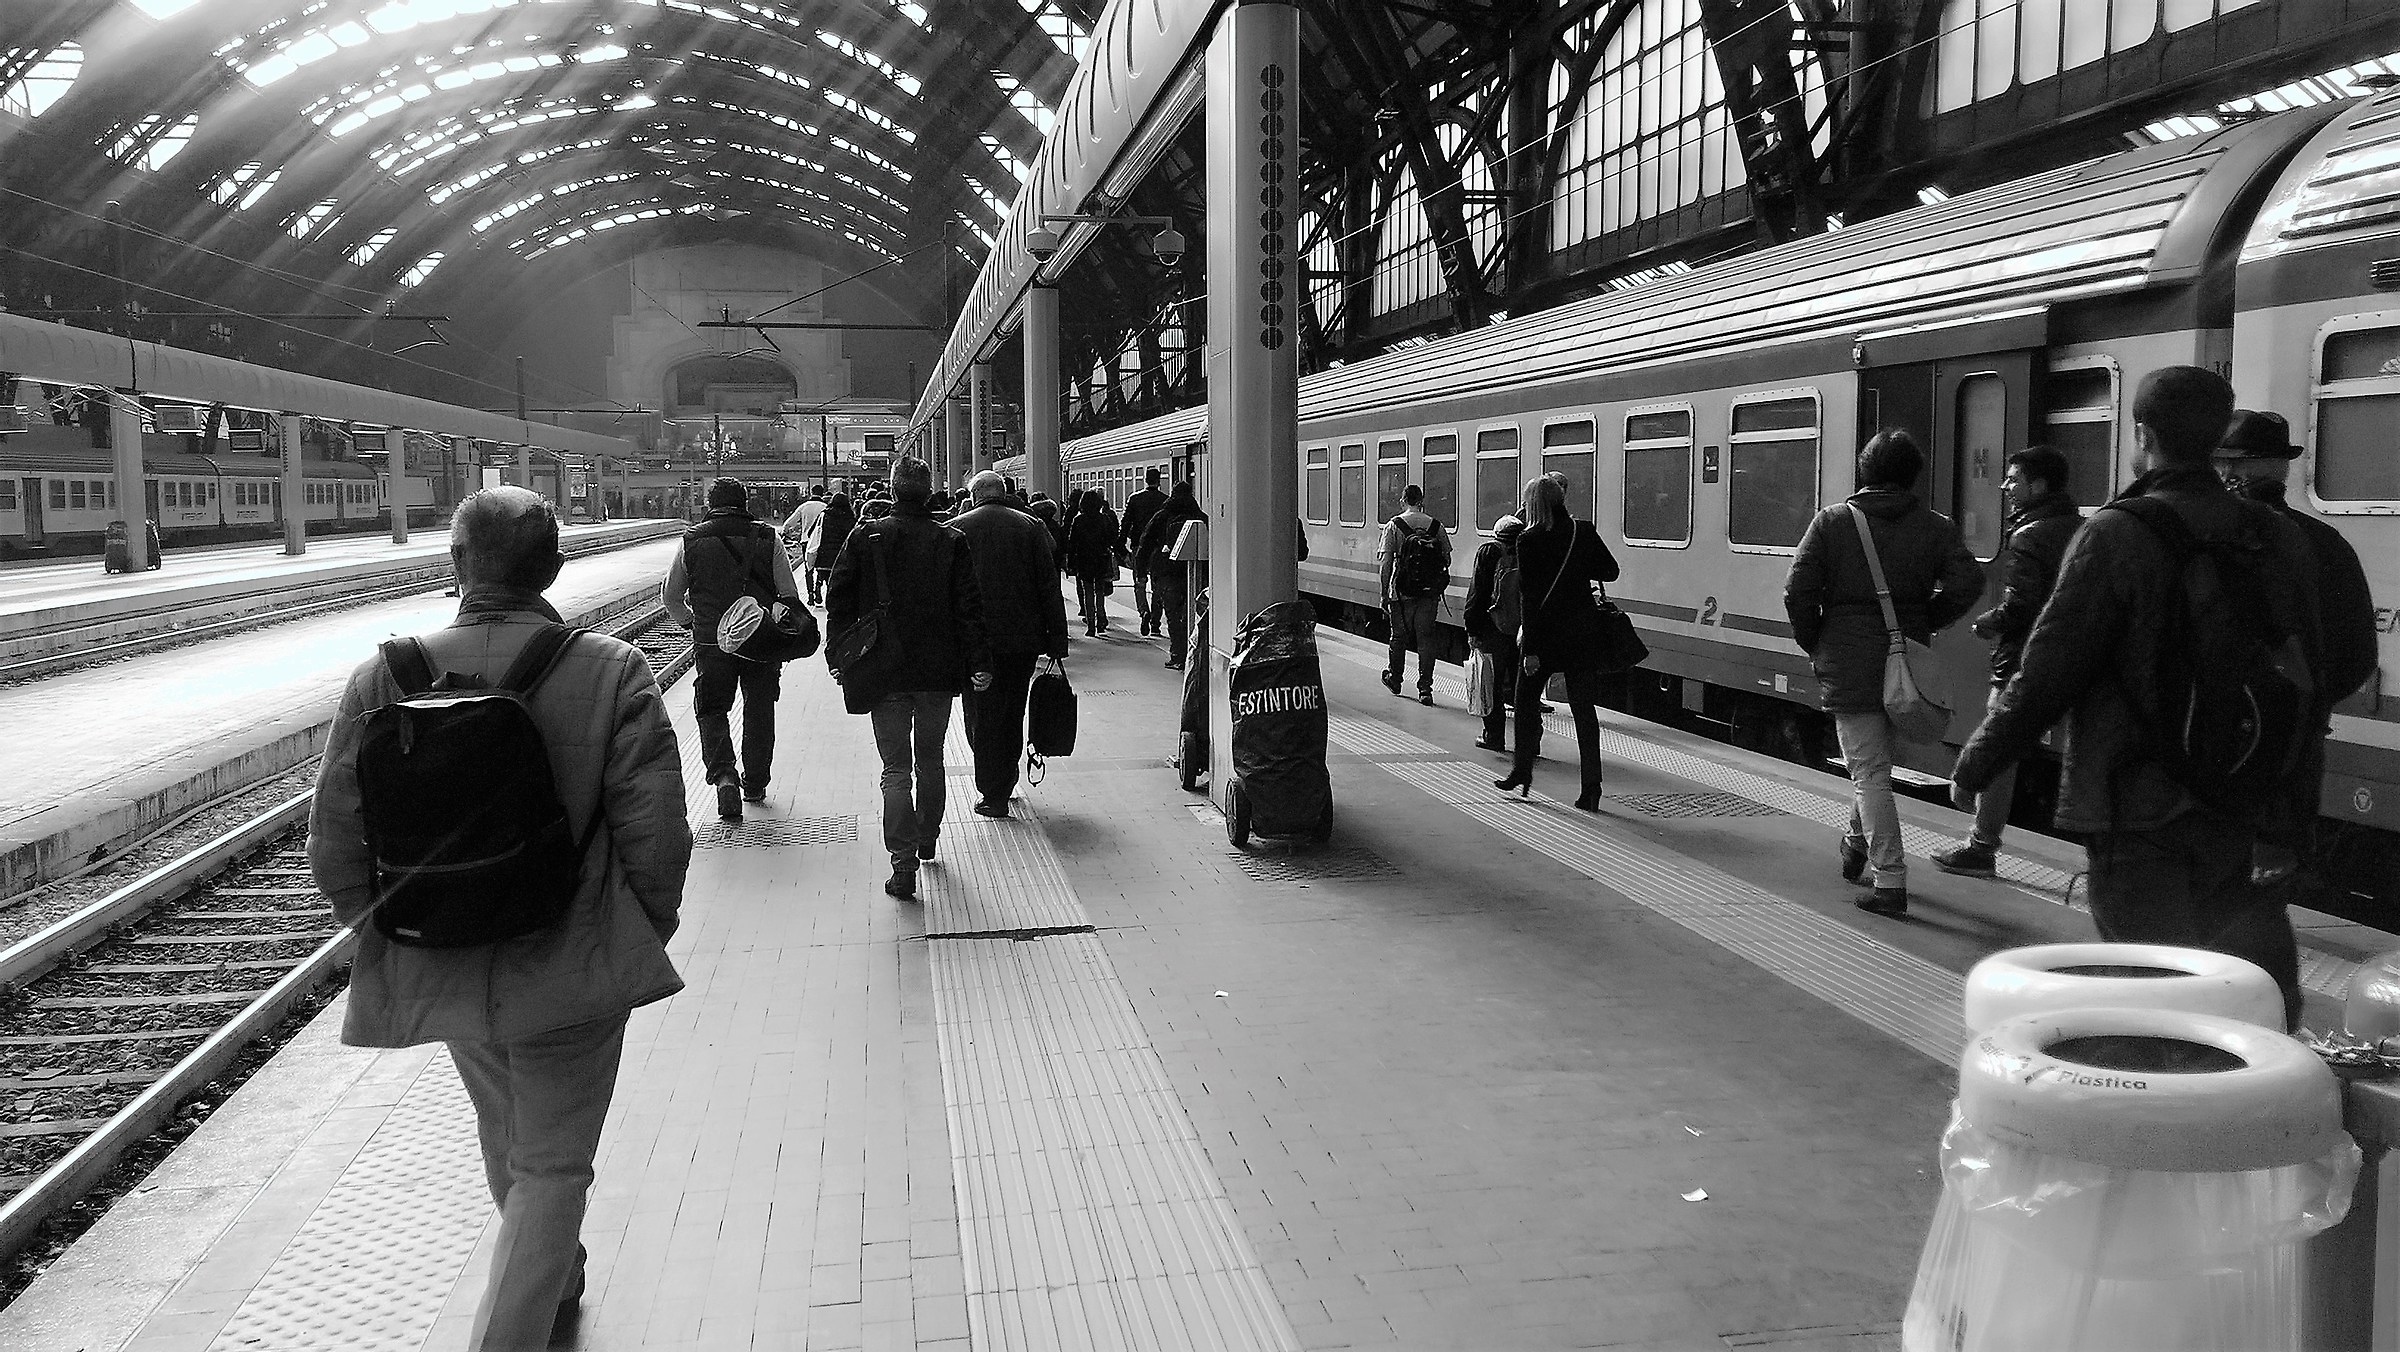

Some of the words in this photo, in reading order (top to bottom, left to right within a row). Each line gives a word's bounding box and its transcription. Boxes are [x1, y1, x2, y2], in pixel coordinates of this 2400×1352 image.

[1701, 596, 1717, 626] 2
[1239, 685, 1318, 716] ESTINTORE
[2059, 1071, 2148, 1090] Plastica
